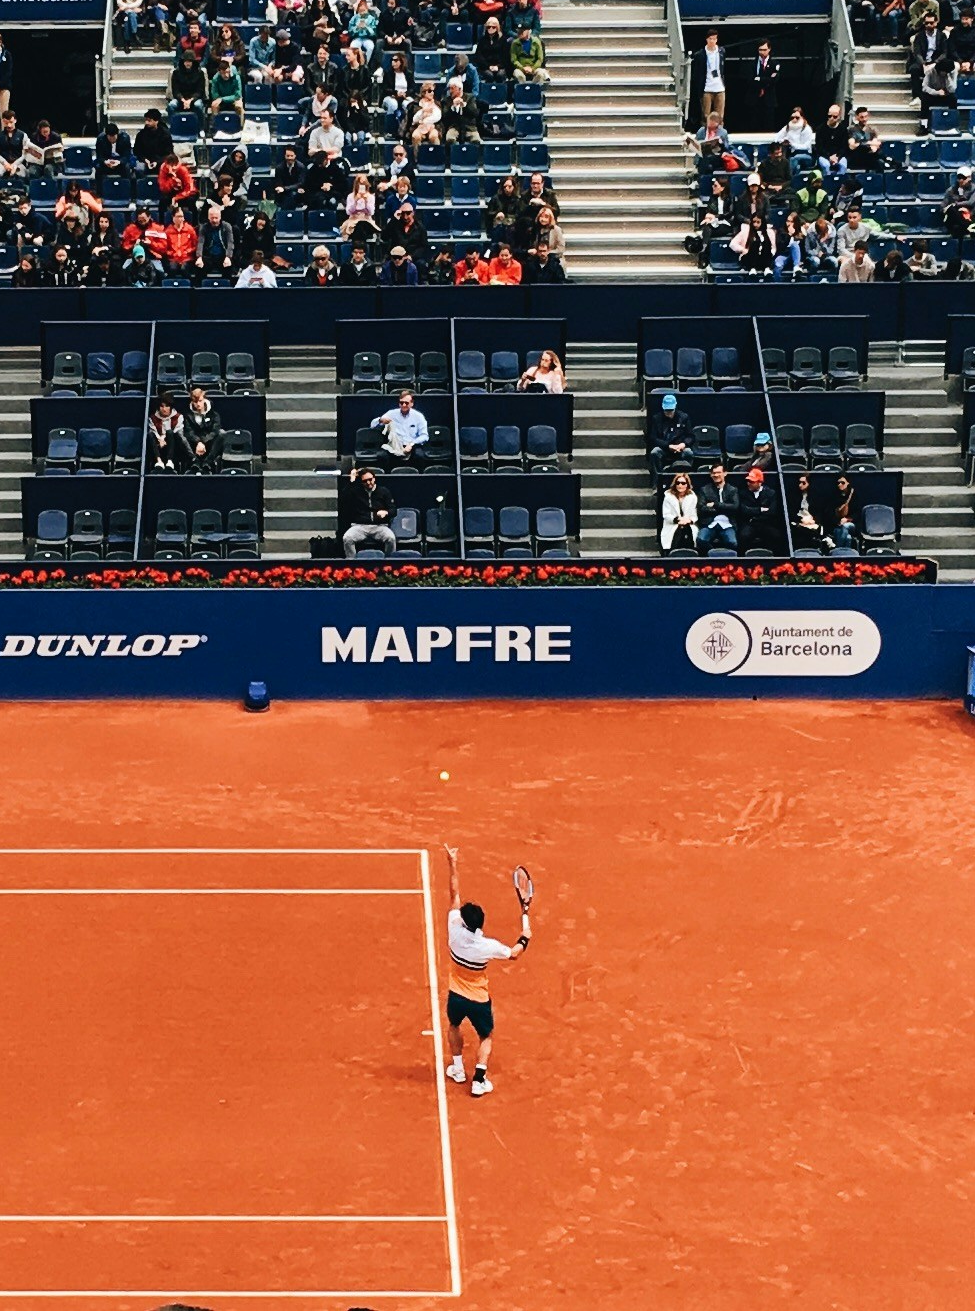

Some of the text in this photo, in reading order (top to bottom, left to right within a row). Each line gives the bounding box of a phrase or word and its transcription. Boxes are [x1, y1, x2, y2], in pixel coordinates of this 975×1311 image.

[761, 626, 854, 640] Ajuntament de
[321, 625, 572, 663] MAPFRE
[760, 641, 853, 656] Barcelona
